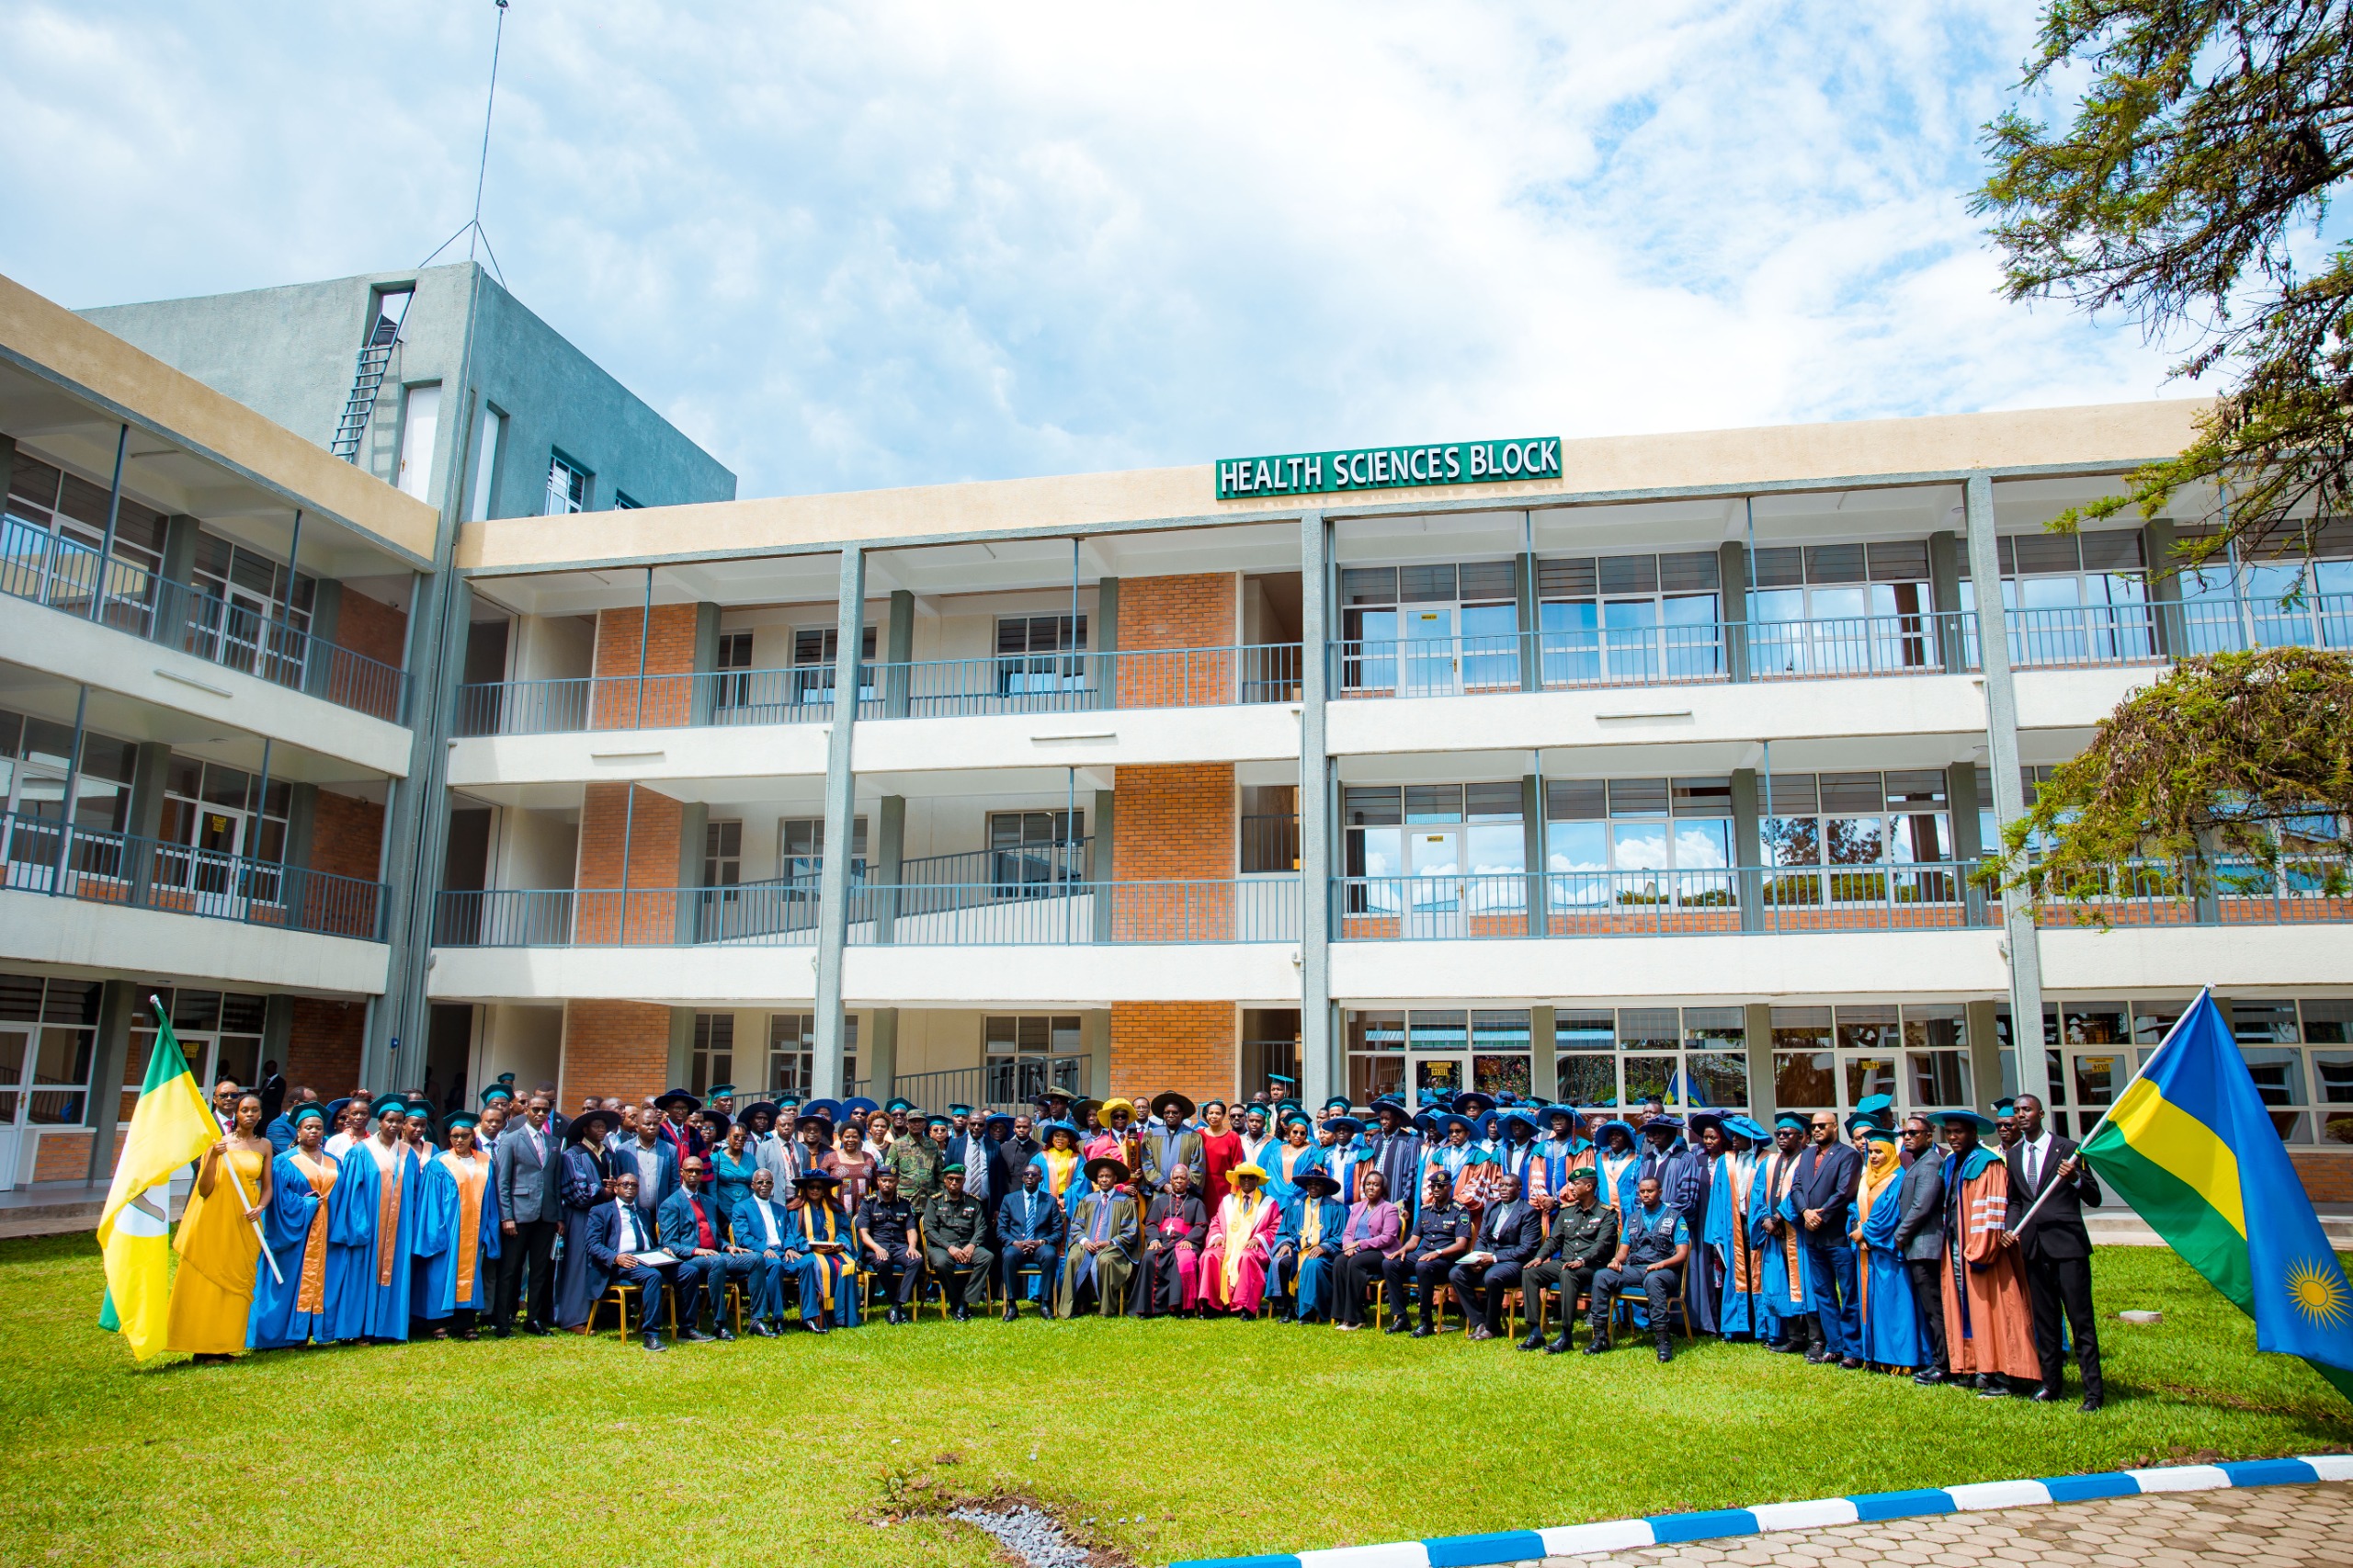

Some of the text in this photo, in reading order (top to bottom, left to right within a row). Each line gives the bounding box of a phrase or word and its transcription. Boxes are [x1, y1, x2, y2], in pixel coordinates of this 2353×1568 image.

[1221, 440, 1558, 493] HEALTH SCIENCES BLOCK
